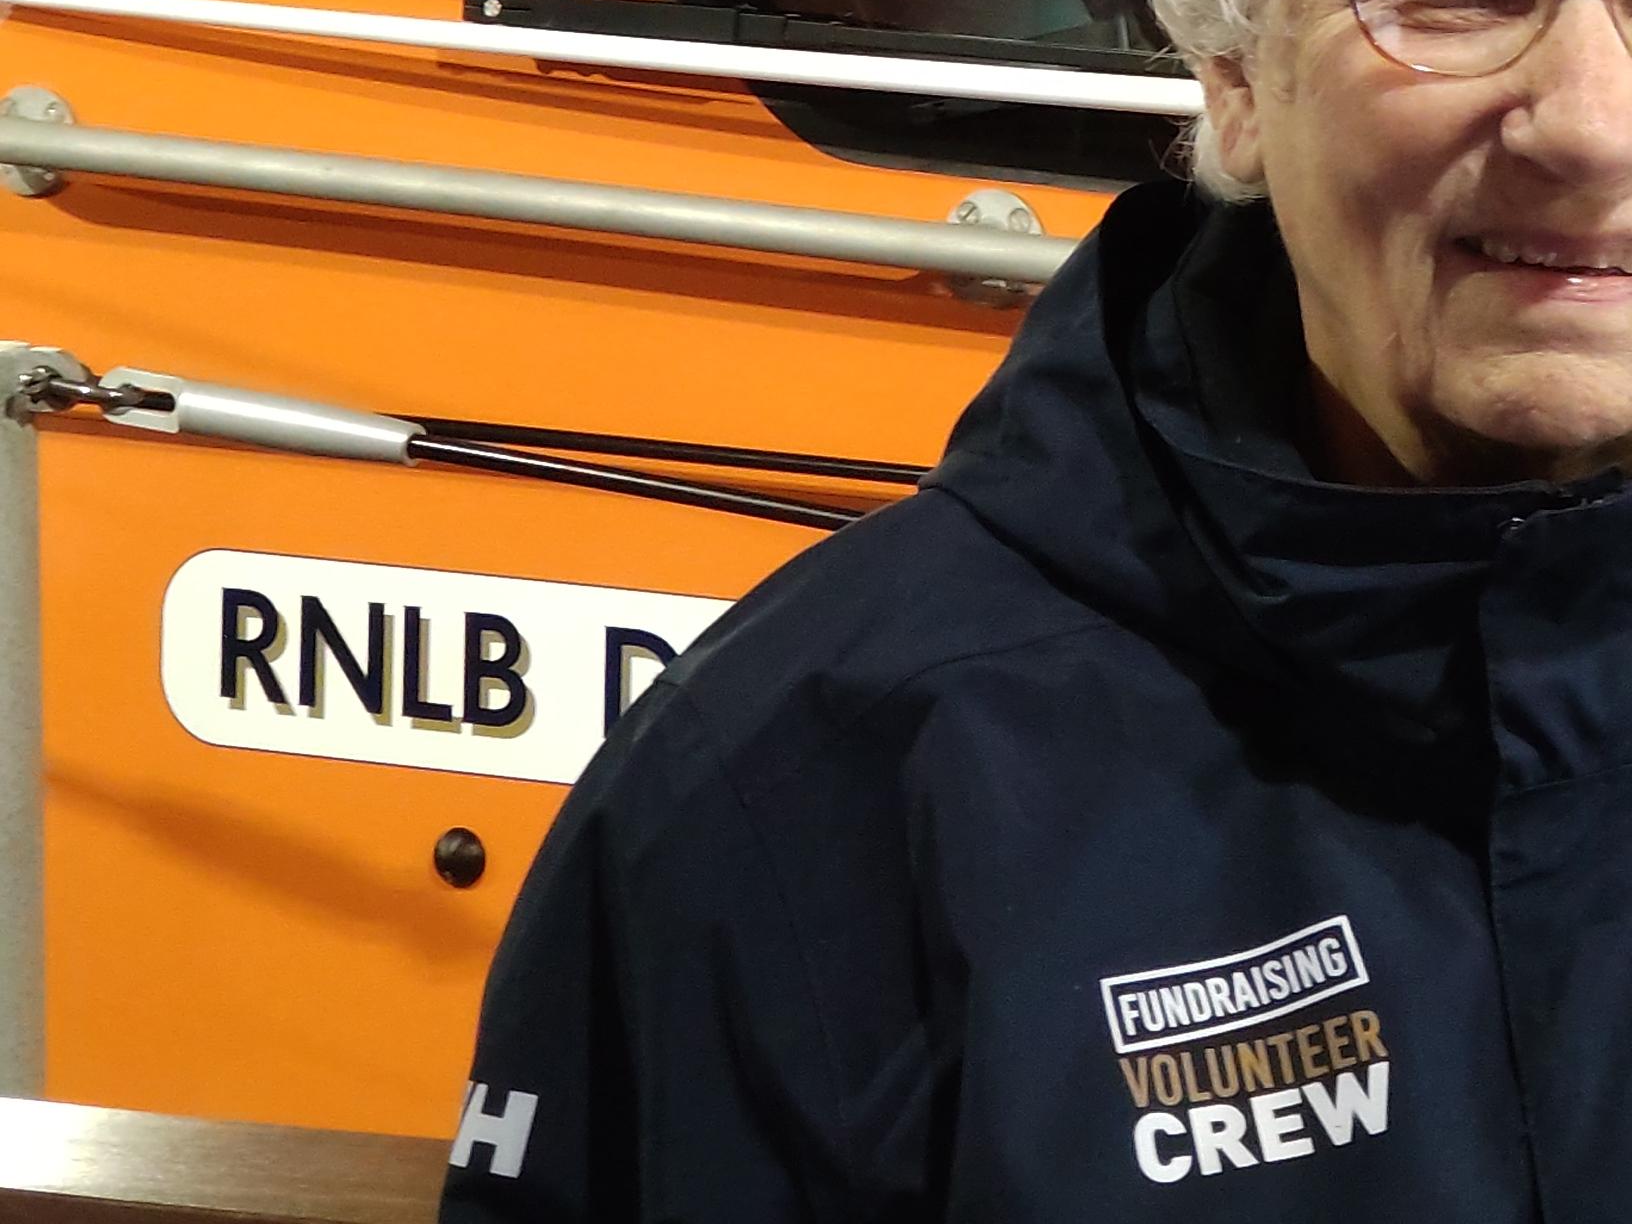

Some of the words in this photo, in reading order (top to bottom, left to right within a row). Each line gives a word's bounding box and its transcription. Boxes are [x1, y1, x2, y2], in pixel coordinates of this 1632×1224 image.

[219, 586, 535, 739] RNLB
[1117, 937, 1349, 1036] FUNDRAISING
[1119, 1010, 1389, 1108] VOLUNTEER
[1134, 1061, 1390, 1183] CREW
